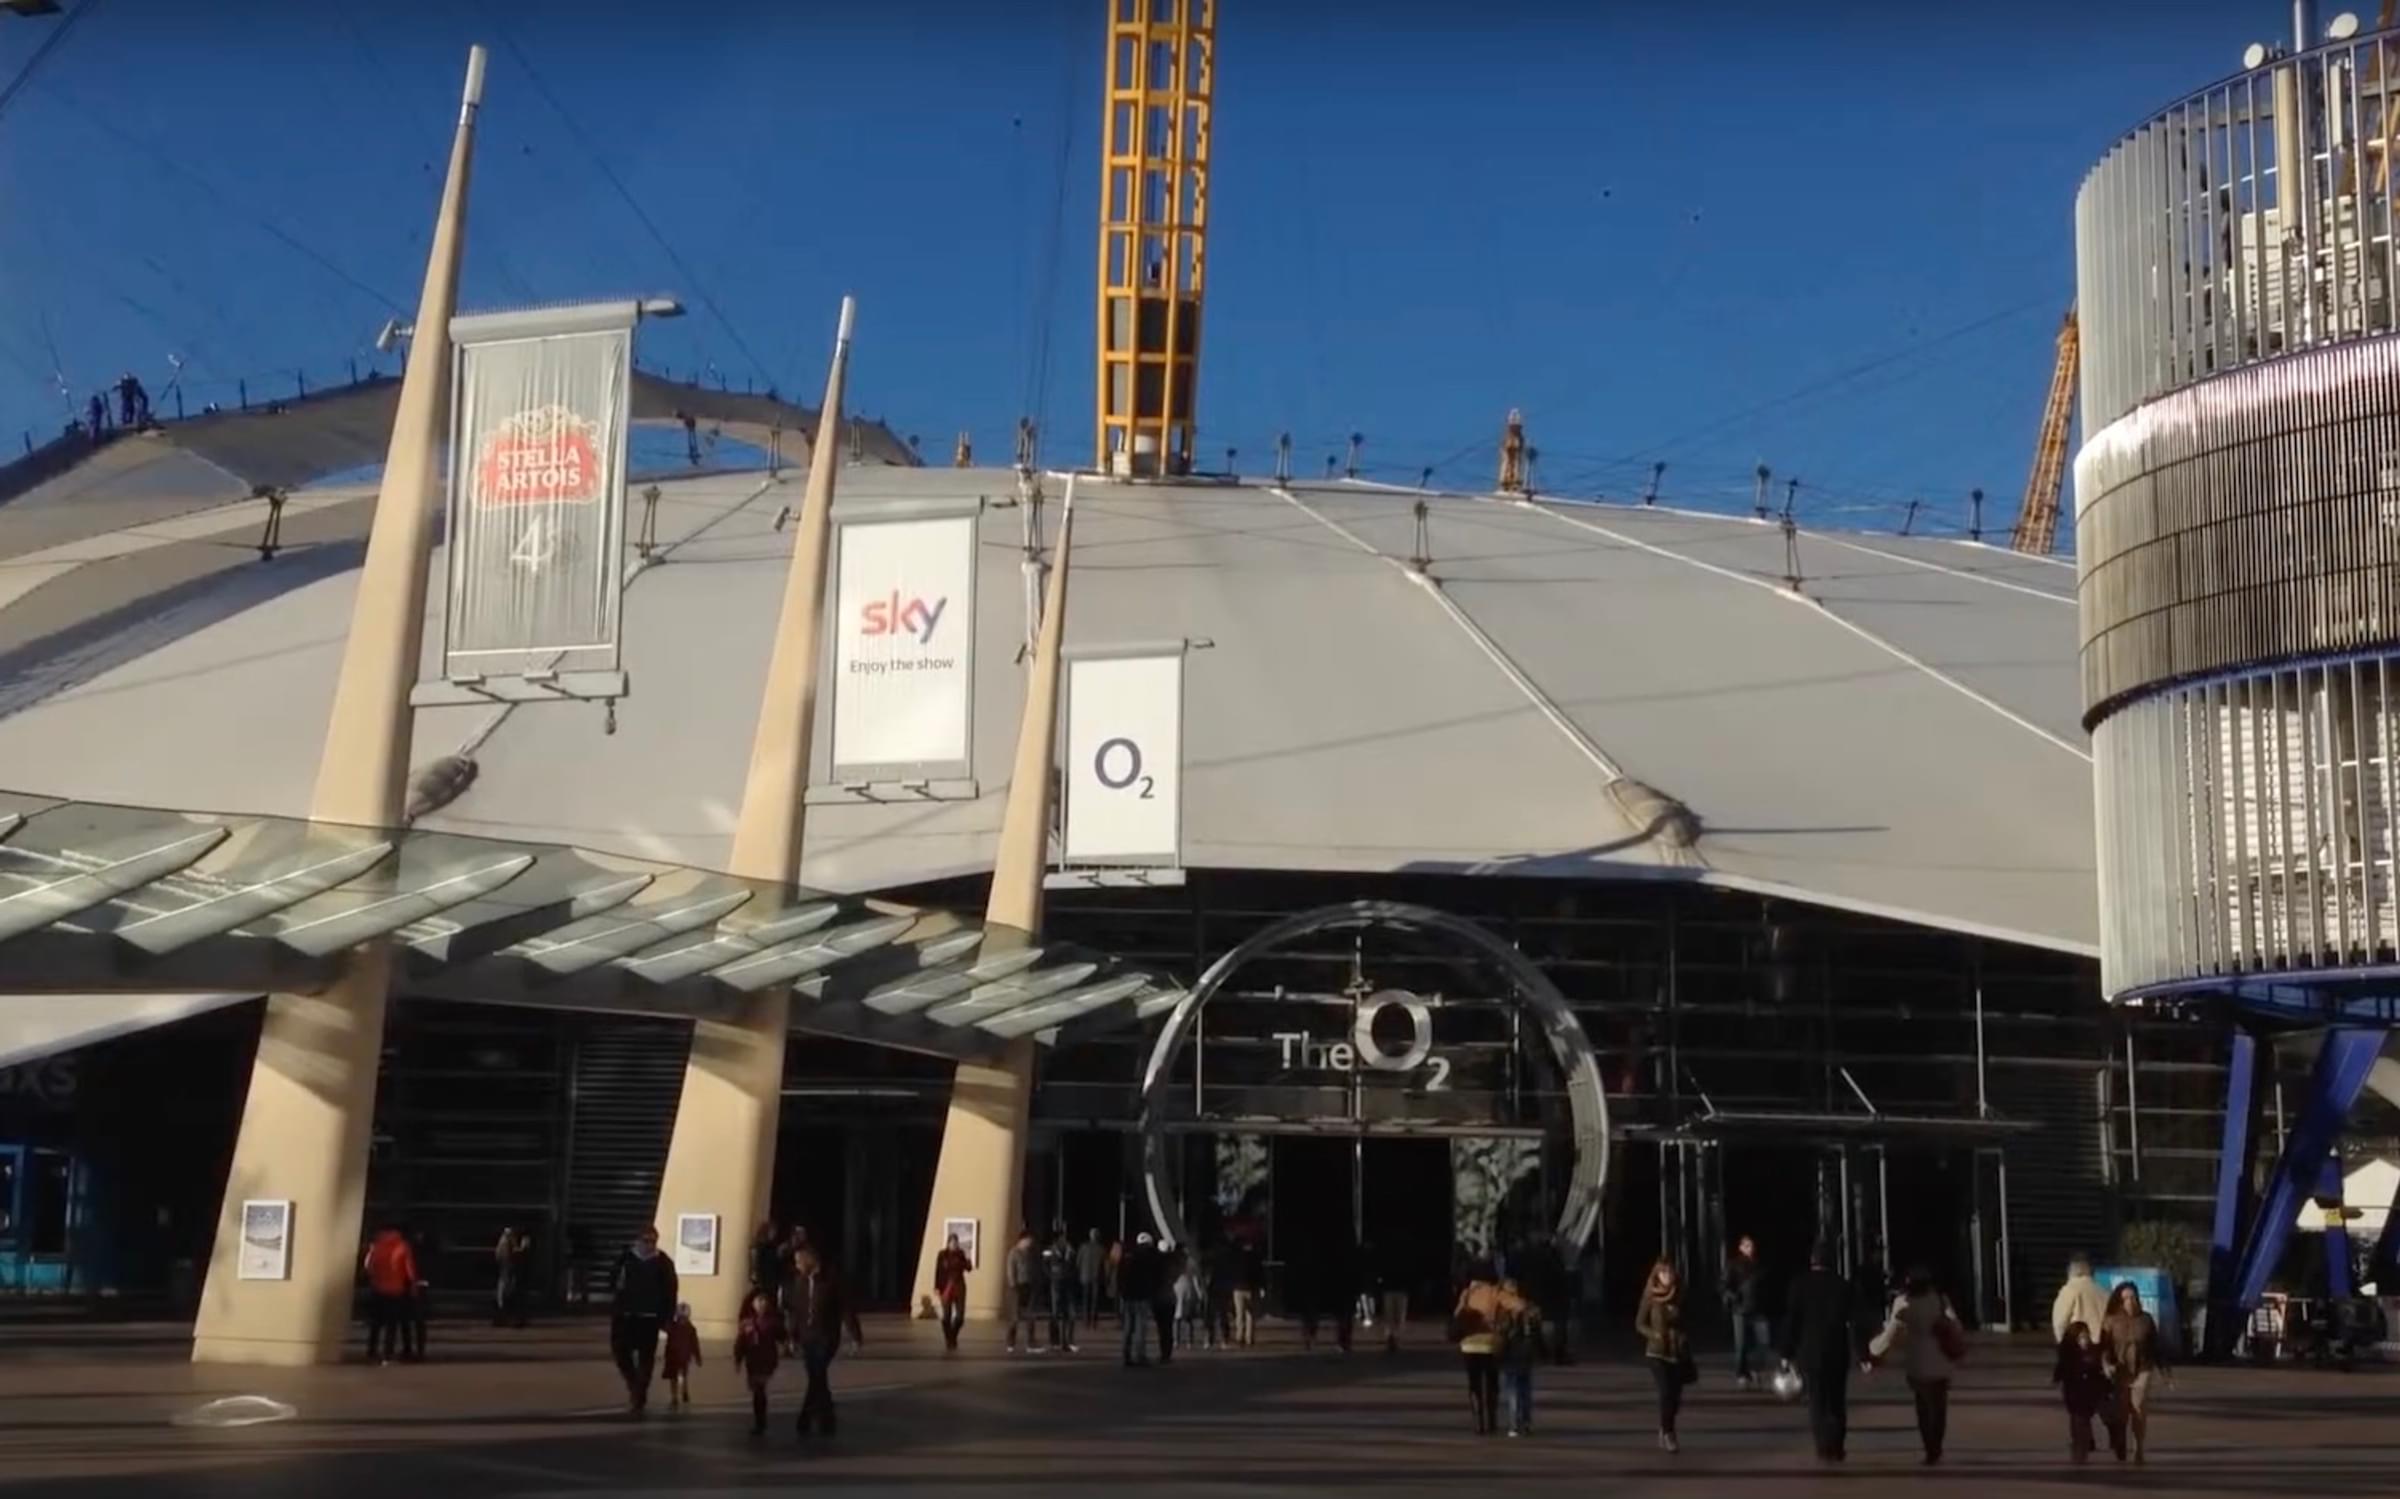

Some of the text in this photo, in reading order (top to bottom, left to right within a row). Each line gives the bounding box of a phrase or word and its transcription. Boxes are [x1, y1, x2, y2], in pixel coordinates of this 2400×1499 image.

[497, 446, 581, 470] STELLA
[498, 468, 581, 491] ARTOIS
[861, 589, 948, 644] sky
[850, 657, 954, 675] Enjoy the show
[1095, 737, 1155, 799] O2
[1272, 989, 1450, 1091] The O2
